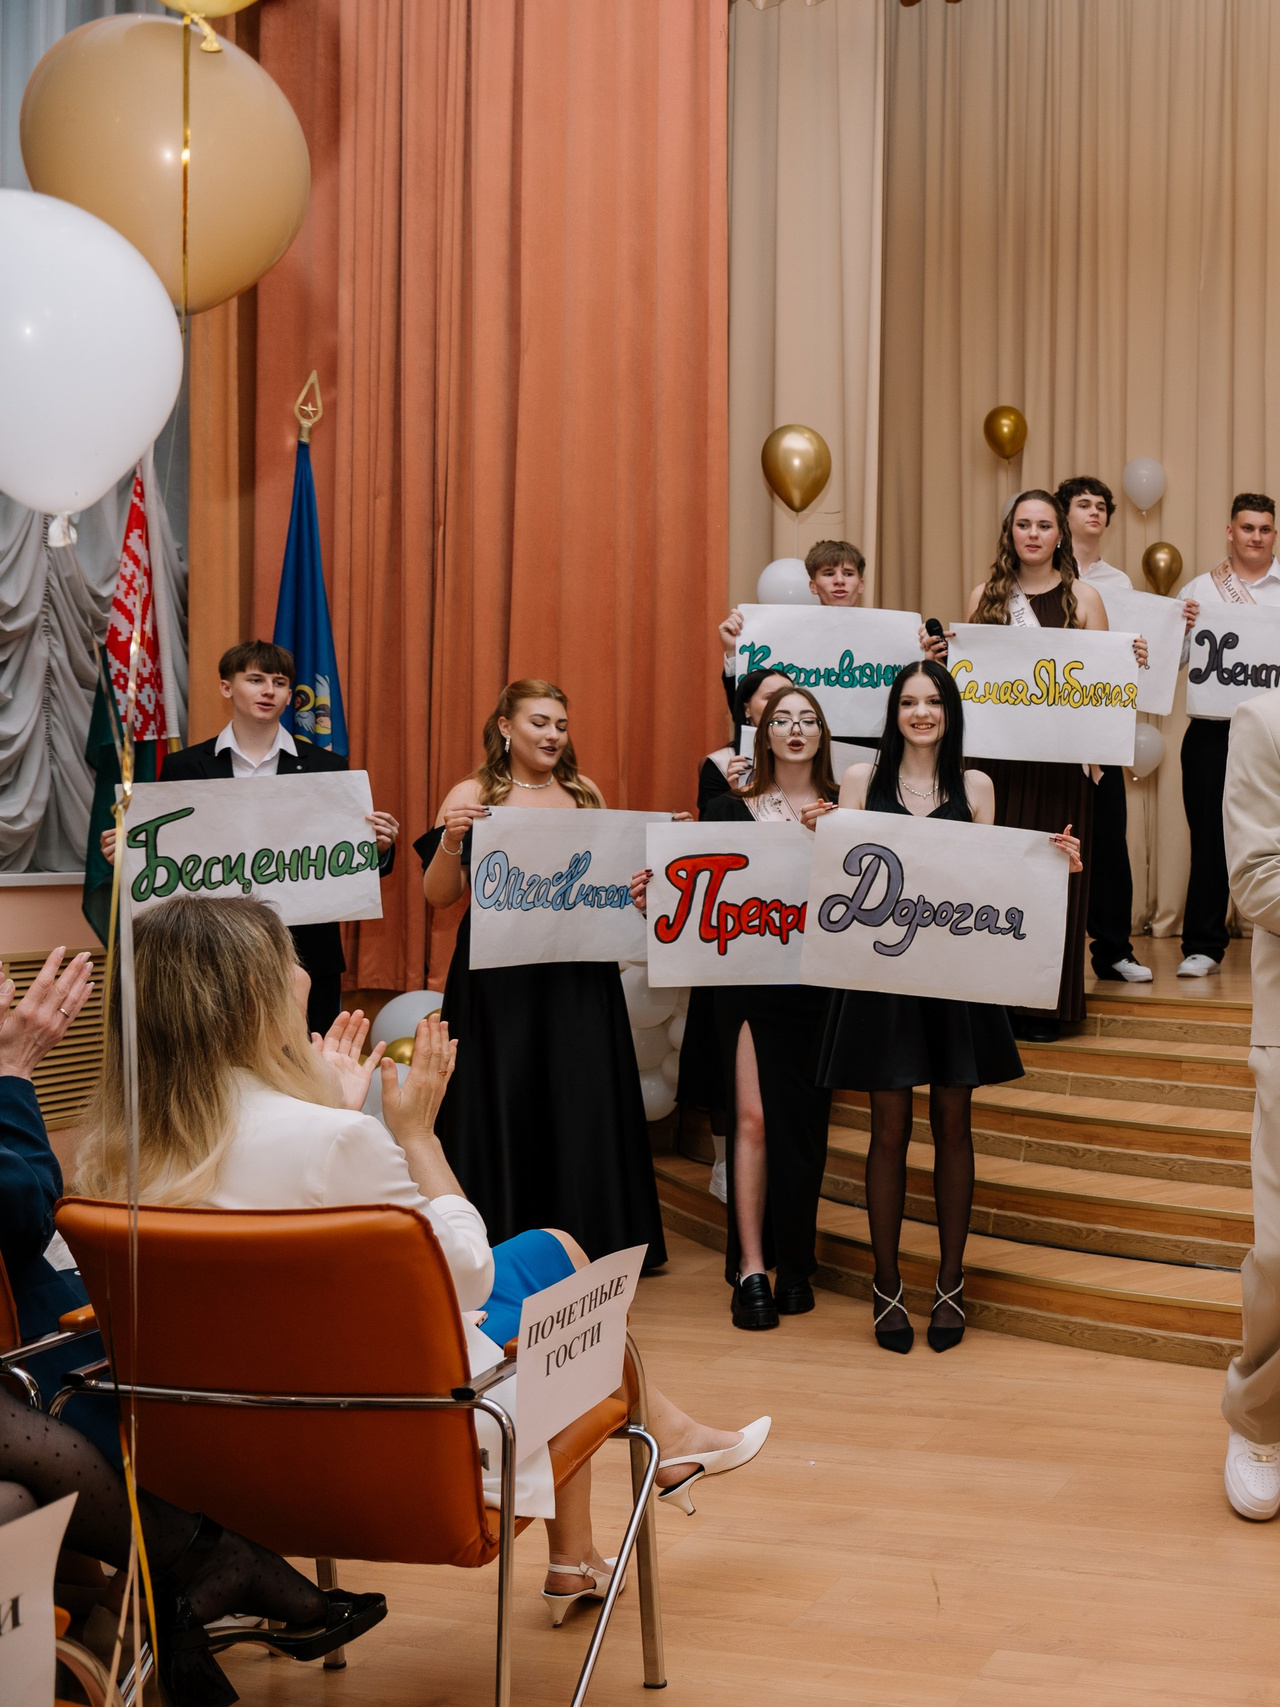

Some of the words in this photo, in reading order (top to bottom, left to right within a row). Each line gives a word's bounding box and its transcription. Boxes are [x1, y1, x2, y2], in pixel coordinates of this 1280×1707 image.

[126, 806, 380, 902] Бесценная
[474, 850, 552, 912] Ольга
[654, 853, 808, 956] Прекр
[818, 843, 1027, 957] Дорогая
[526, 1275, 628, 1350] ПОЧЕТНЫЕ
[545, 1321, 603, 1377] ГОСТИ
